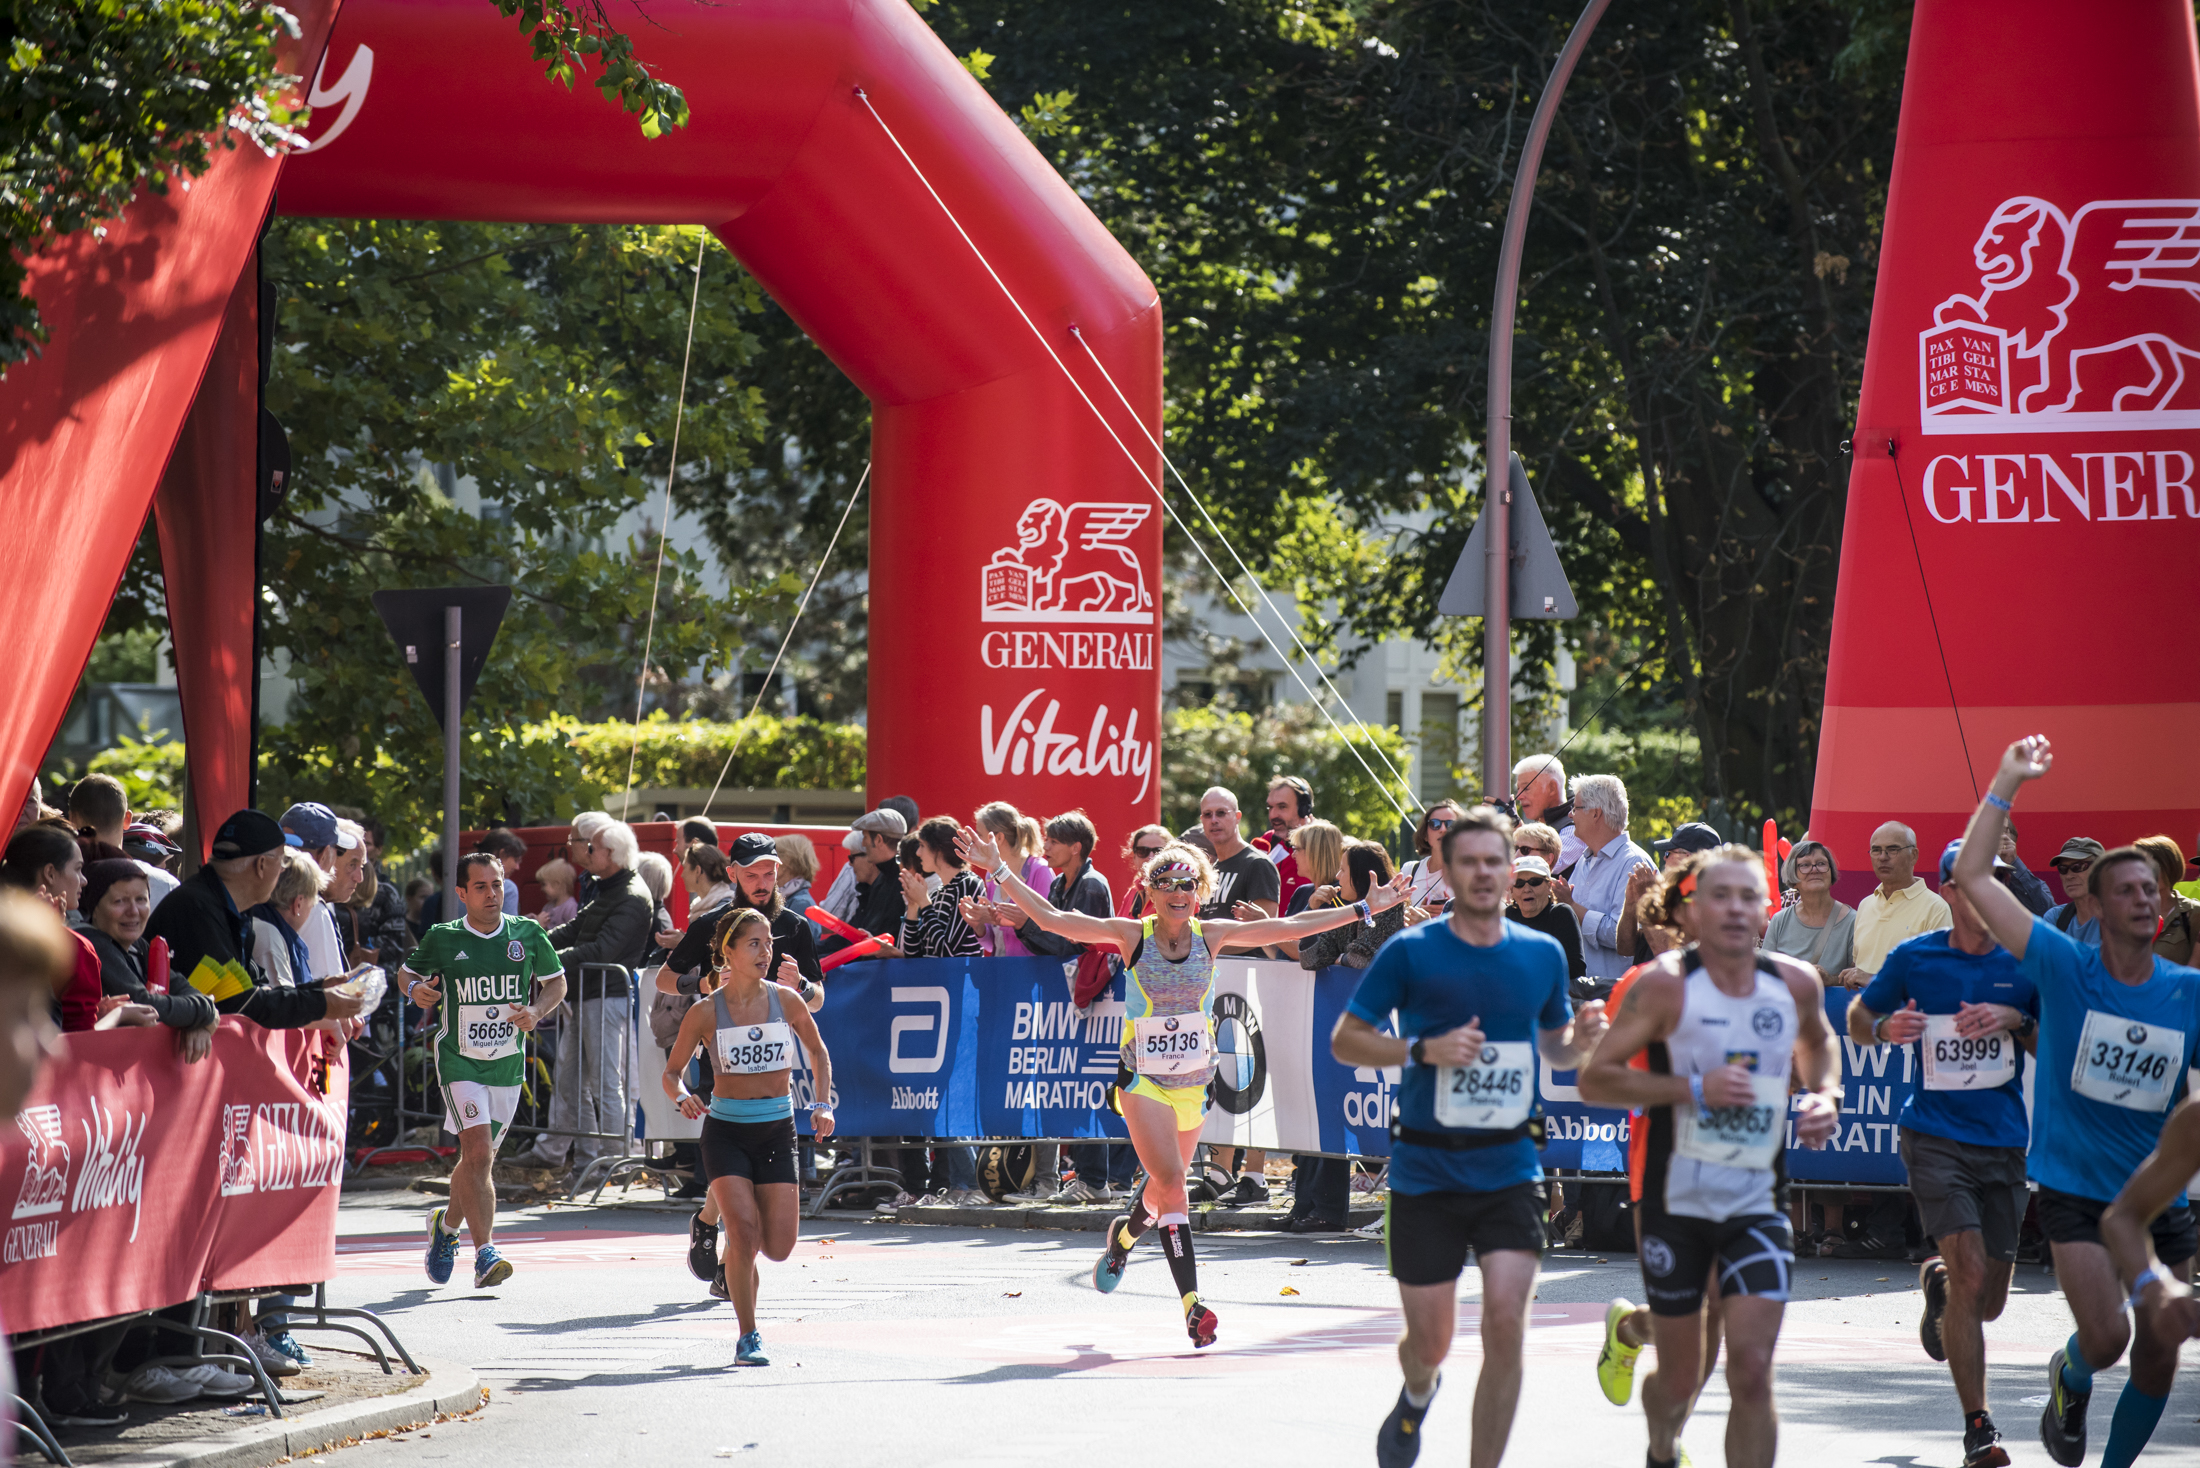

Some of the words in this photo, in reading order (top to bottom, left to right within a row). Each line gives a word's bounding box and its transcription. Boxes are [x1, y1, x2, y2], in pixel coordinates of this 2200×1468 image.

[1929, 337, 1955, 356] PAX
[1962, 336, 1991, 353] VAN
[1929, 351, 1956, 369] TIBI
[1962, 351, 1996, 368] GELI
[1929, 365, 1959, 384] MAR
[1963, 365, 1991, 381] STA
[1929, 382, 1947, 397] CE
[1950, 379, 1959, 392] E
[980, 630, 1154, 670] GENERALI
[980, 688, 1153, 805] Vitality
[454, 974, 523, 1003] MIGUEL
[468, 1021, 514, 1040] 56656
[1011, 1001, 1081, 1041] BMW
[472, 1040, 493, 1048] Miguel
[730, 1042, 784, 1066] 35857
[1146, 1031, 1199, 1053] 55136
[1935, 1037, 2001, 1062] 63999
[747, 1064, 768, 1072] Isabel
[1008, 1047, 1079, 1074] BERLIN
[1960, 1062, 1977, 1071] Joel
[2090, 1041, 2169, 1081] 33146
[1452, 1068, 1523, 1096] 28446
[2108, 1071, 2141, 1088] Robert
[891, 1086, 939, 1110] Abbott
[1343, 1082, 1398, 1129] adi
[256, 1100, 347, 1193] GENER
[71, 1095, 146, 1243] Vitality
[3, 1220, 59, 1264] GENERALI
